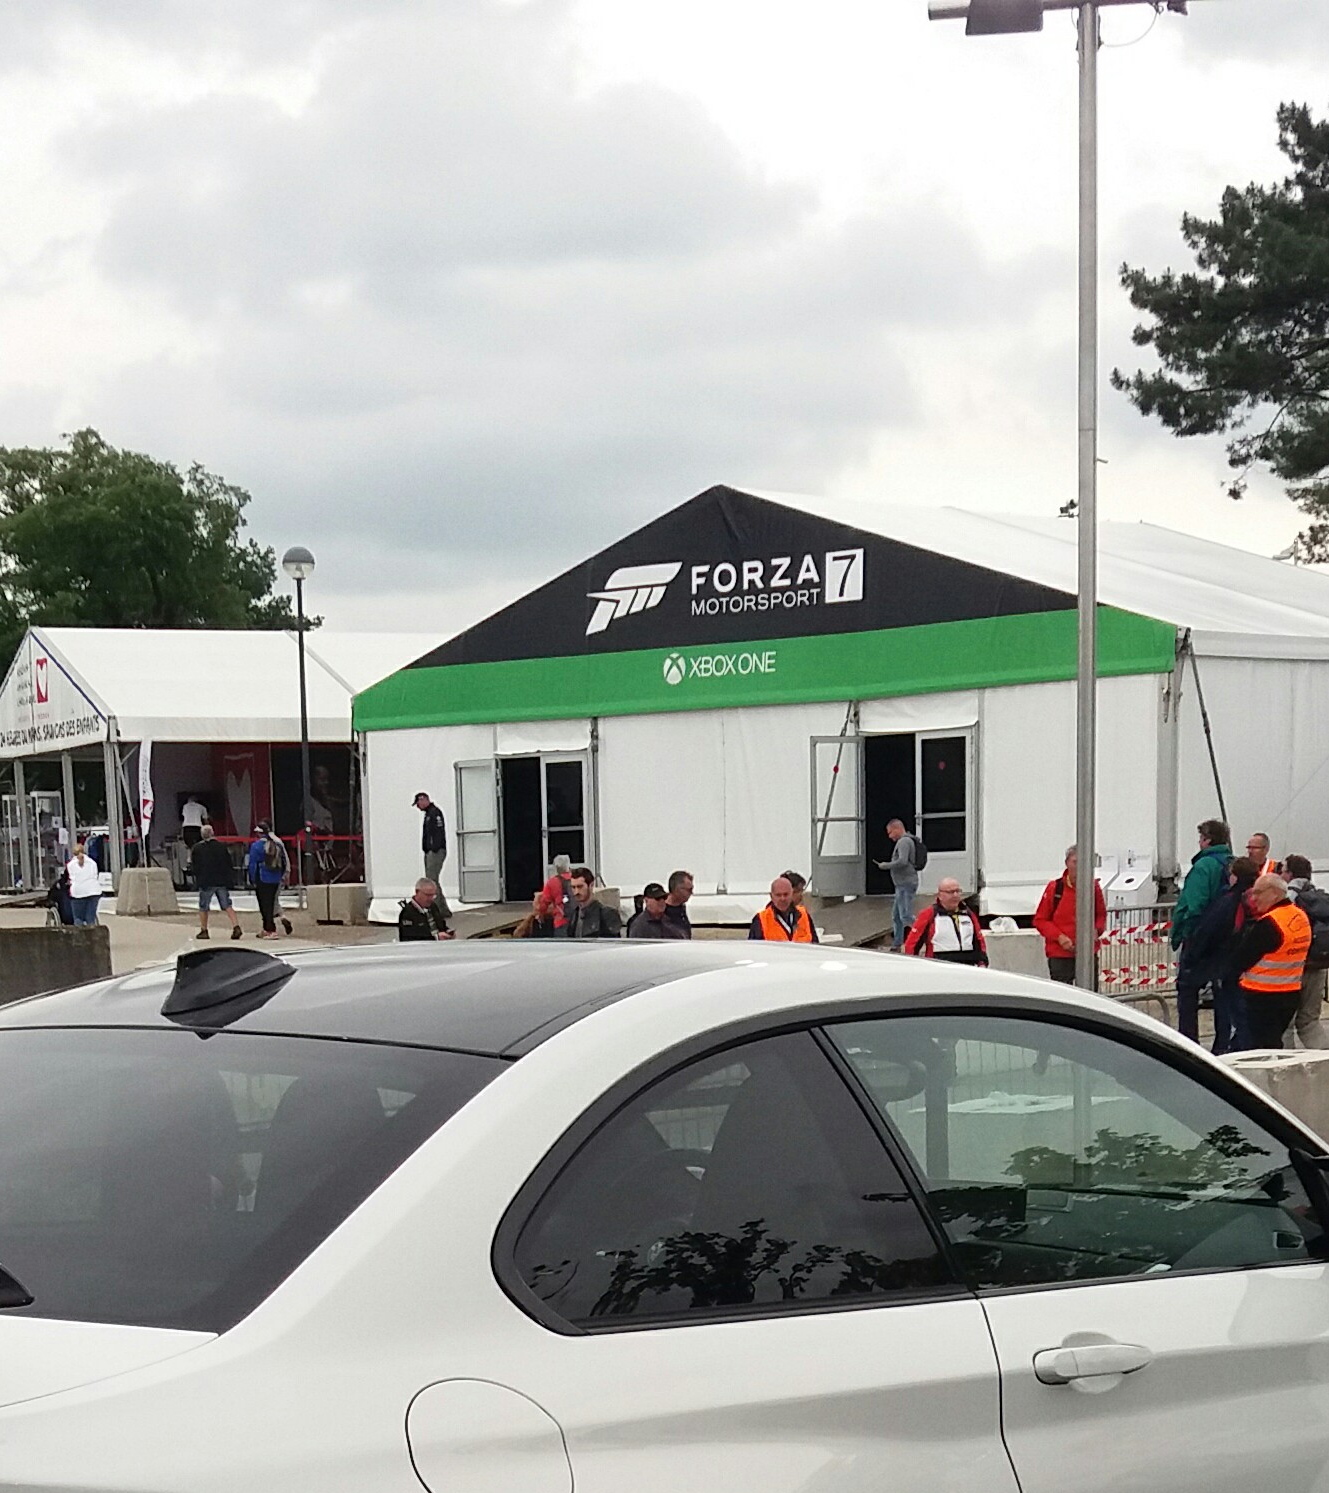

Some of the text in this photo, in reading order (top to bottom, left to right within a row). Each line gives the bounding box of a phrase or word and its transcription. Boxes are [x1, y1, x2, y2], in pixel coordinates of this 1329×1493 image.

[690, 552, 858, 599] FORZA 7
[690, 588, 821, 616] MOTORSPORT
[689, 650, 777, 679] XBOX ONE
